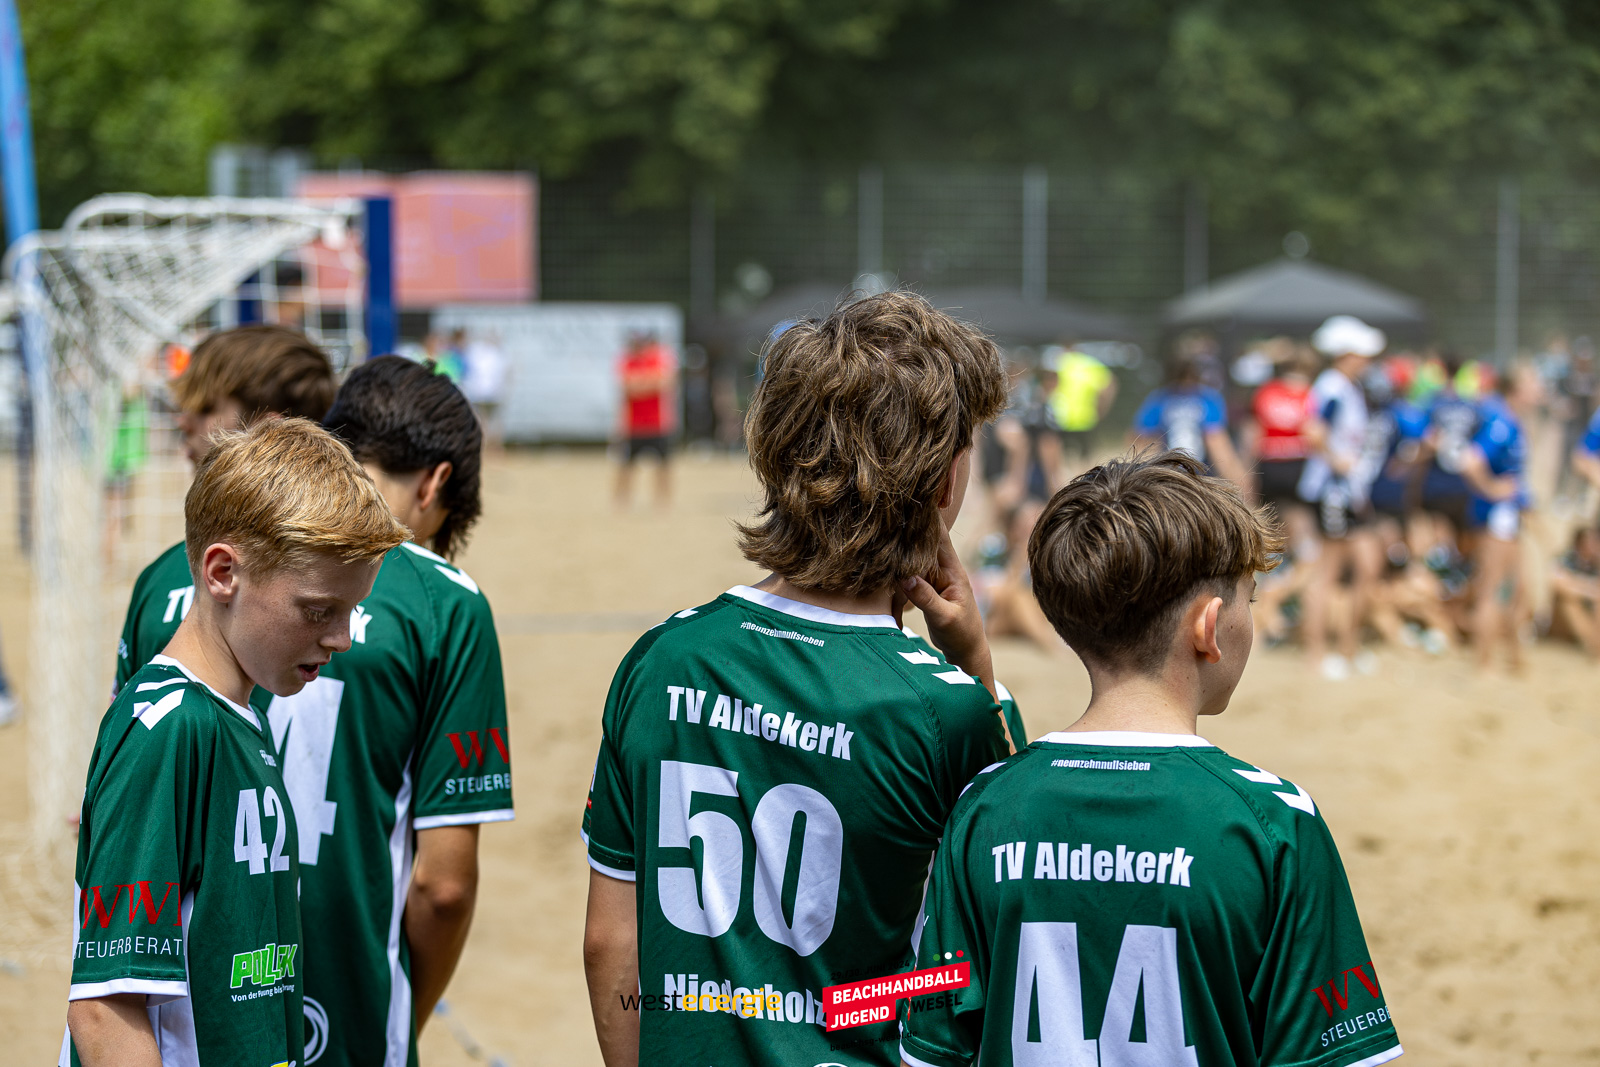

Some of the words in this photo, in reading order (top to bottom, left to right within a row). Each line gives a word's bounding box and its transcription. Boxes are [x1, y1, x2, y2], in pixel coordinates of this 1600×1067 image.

[667, 685, 706, 724] TV
[708, 694, 855, 761] Aldekerk
[1051, 759, 1151, 771] #neunzehnnullsieben
[233, 786, 290, 875] 42
[657, 759, 844, 957] 50
[991, 842, 1027, 883] TV
[1034, 841, 1195, 888] Aldekerk
[74, 936, 185, 959] TEUERBERAT
[1011, 921, 1200, 1067] 44
